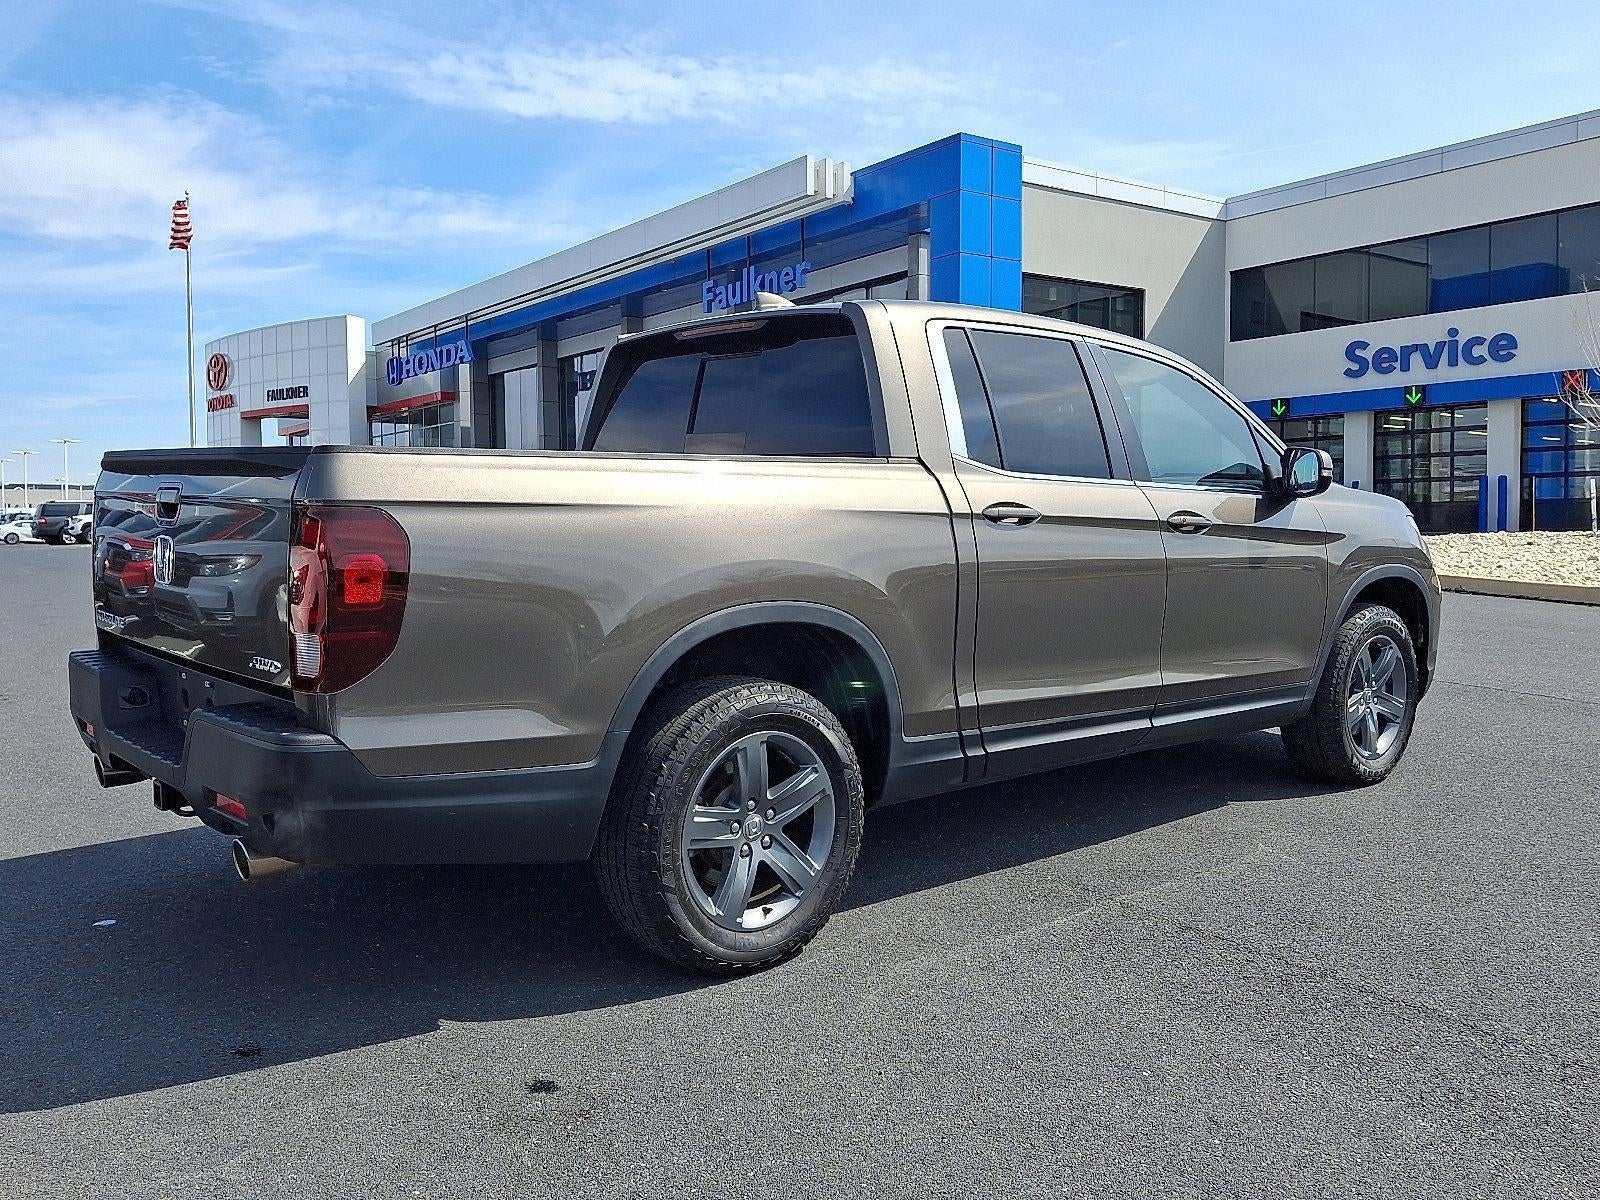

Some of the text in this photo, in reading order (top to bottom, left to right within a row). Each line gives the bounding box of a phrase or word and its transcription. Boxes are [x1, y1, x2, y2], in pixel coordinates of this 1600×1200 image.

[702, 260, 812, 313] Faulkner
[401, 340, 473, 378] HONDA
[1343, 327, 1518, 378] Service
[266, 385, 309, 402] FAULKNER
[248, 656, 282, 674] AWD
